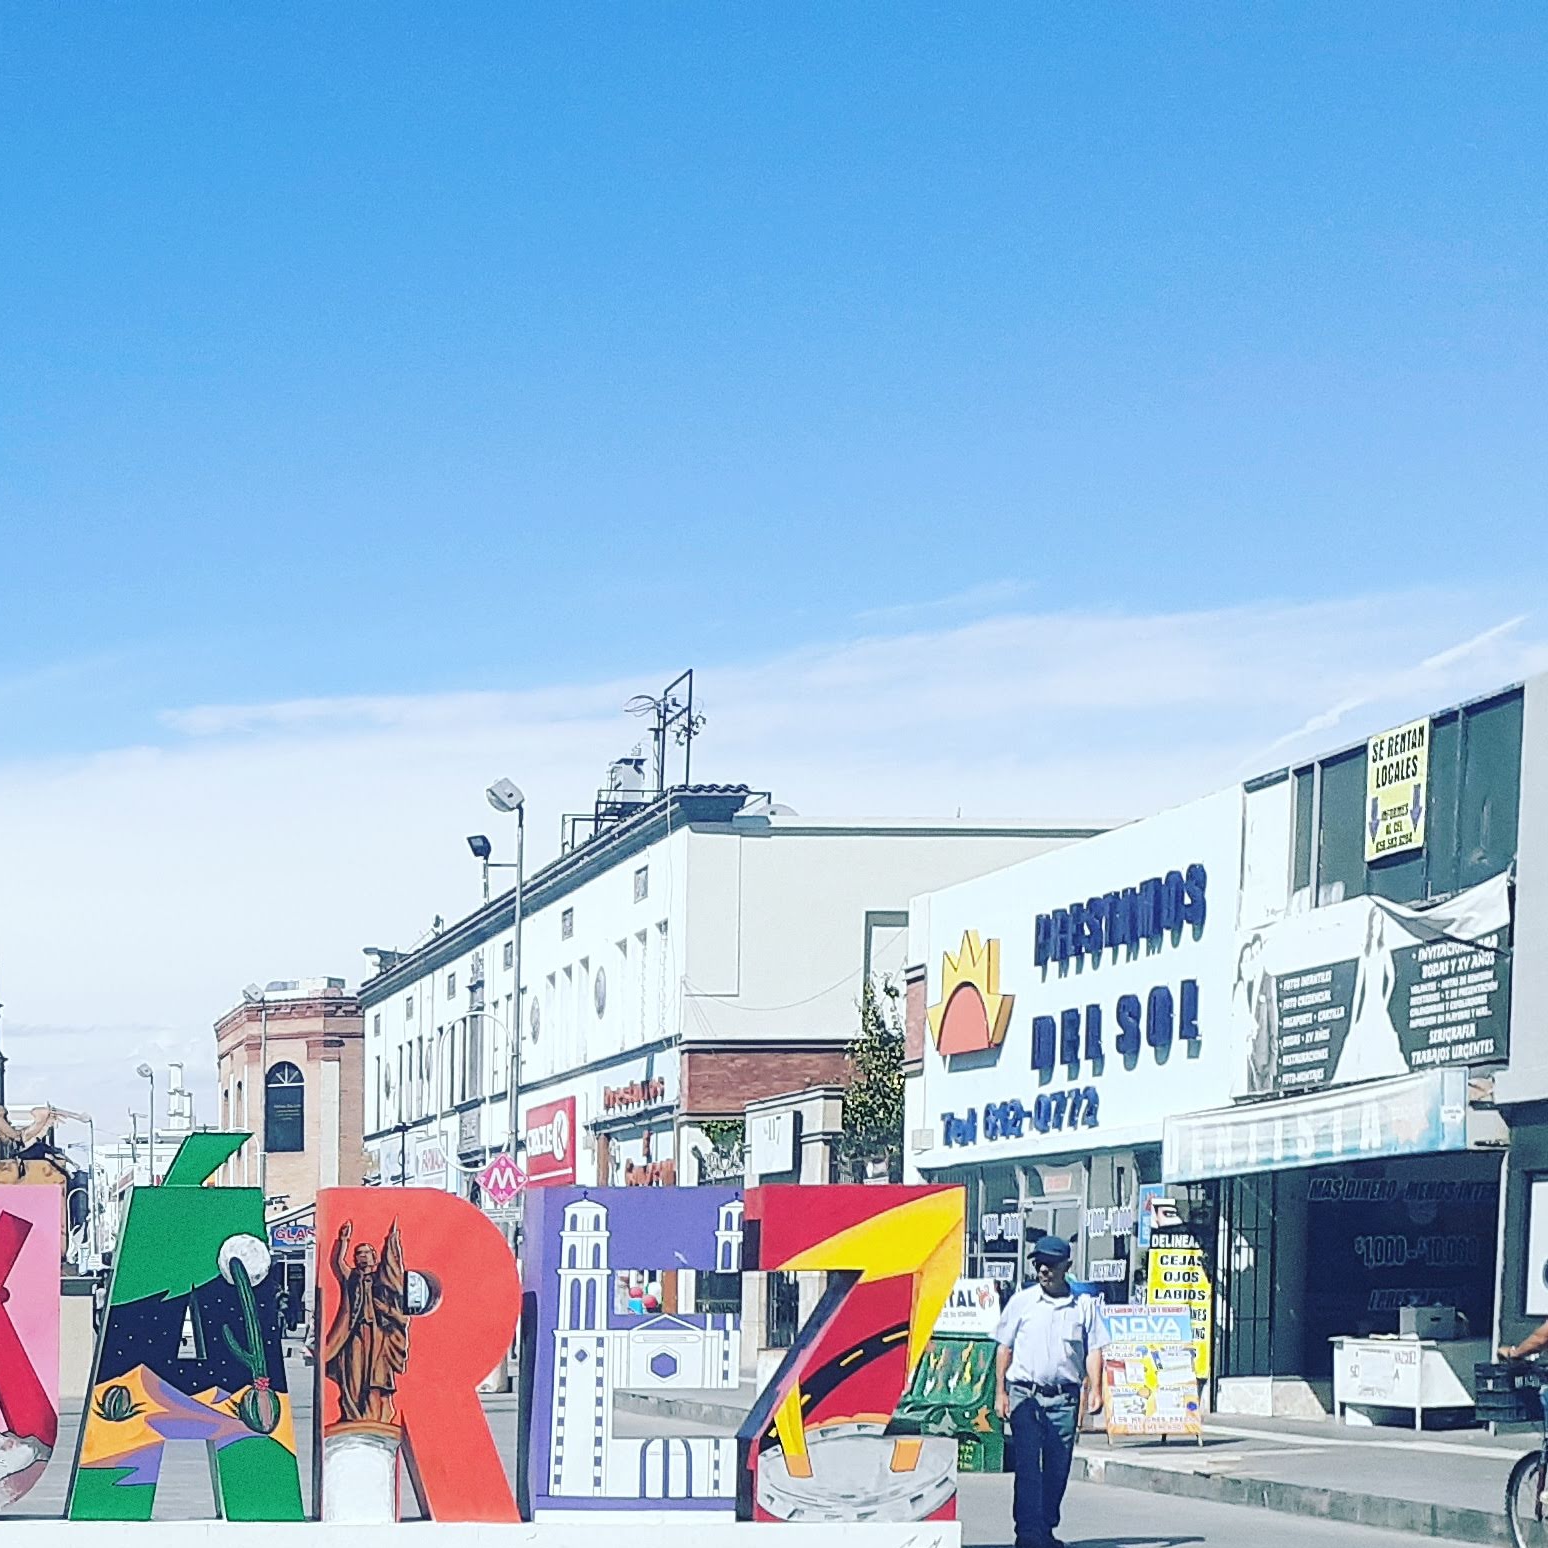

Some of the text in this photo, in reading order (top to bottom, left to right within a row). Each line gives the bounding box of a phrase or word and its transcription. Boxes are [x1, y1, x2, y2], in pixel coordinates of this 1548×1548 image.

[1372, 725, 1425, 763] SE RENTAN
[1376, 754, 1418, 789] LOCALES
[1033, 863, 1207, 967] PRESTAMOS
[1031, 979, 1199, 1070] DEL SOL
[487, 1167, 517, 1190] M
[1160, 1254, 1202, 1267] CEJAS
[1163, 1271, 1200, 1283] OJOS
[1155, 1288, 1206, 1302] LABIOS
[1110, 1317, 1181, 1335] NOVA
